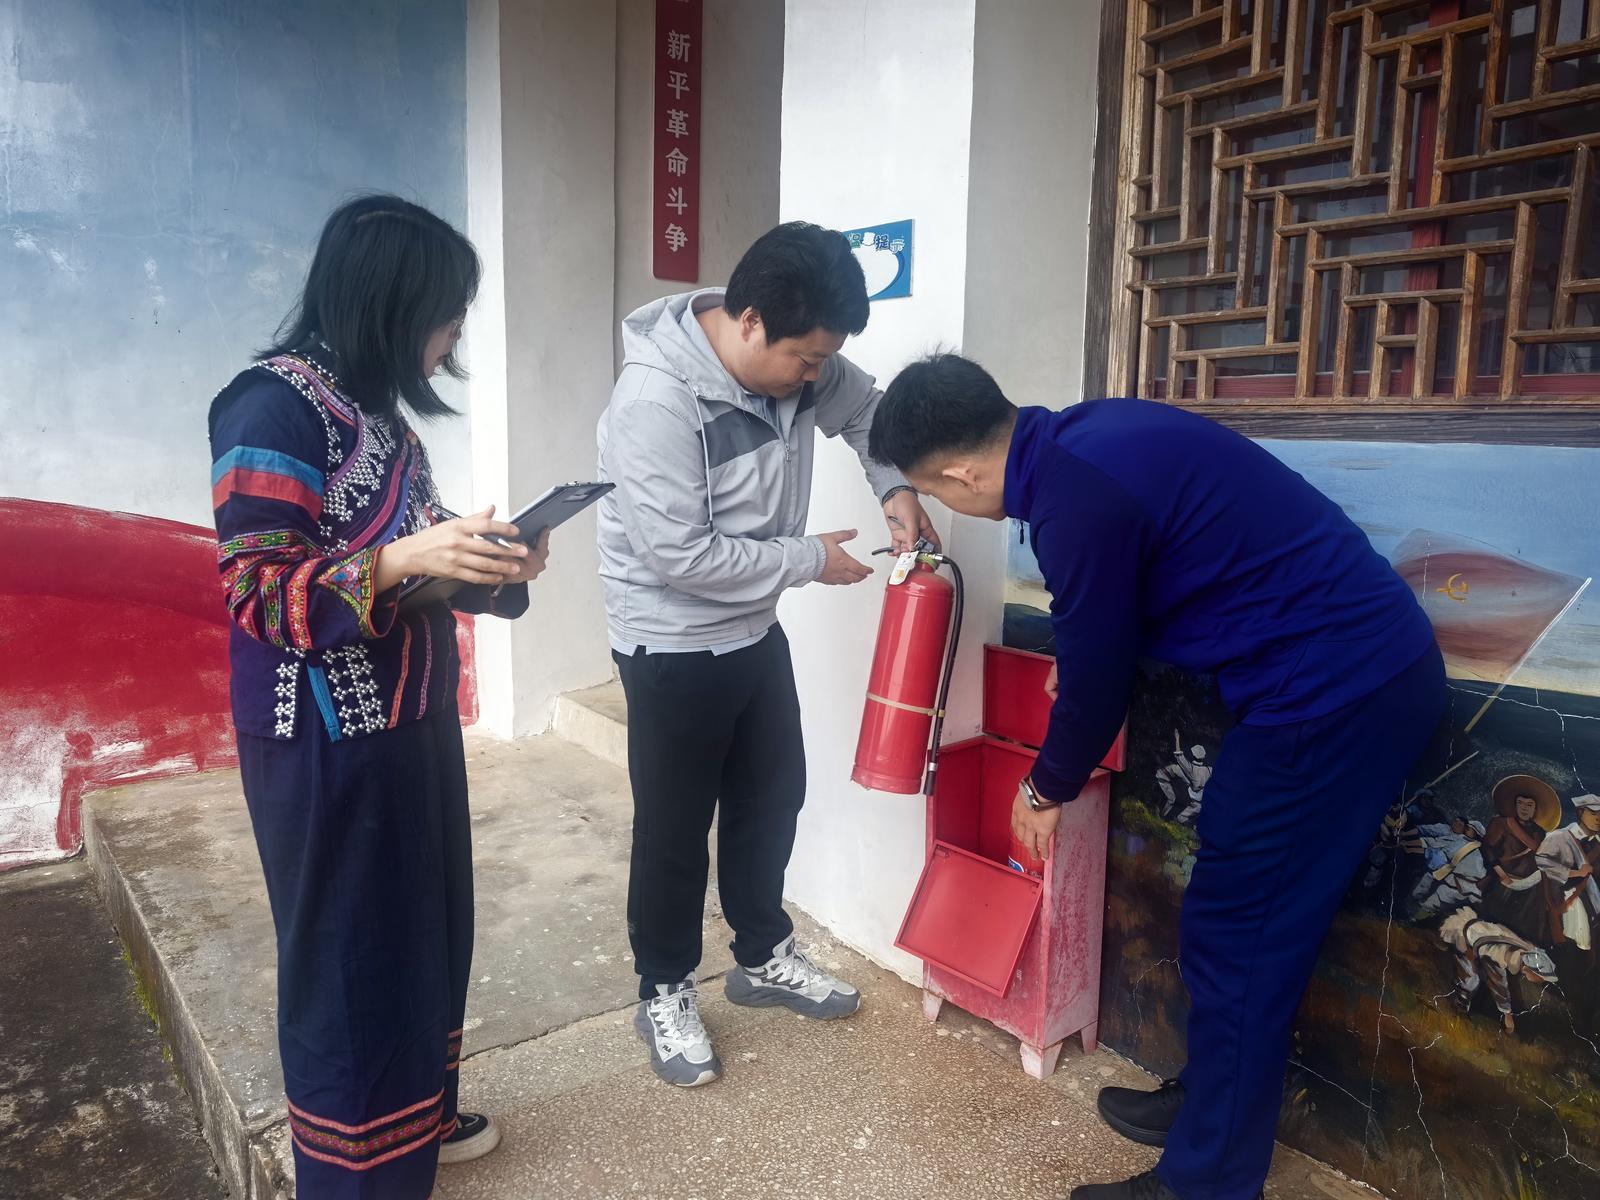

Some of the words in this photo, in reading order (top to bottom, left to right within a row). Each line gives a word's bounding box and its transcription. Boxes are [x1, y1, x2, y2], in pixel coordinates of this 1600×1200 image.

[664, 29, 691, 253] 新平革命斗争
[847, 231, 906, 254] 温提示
[662, 1044, 672, 1053] FILA
